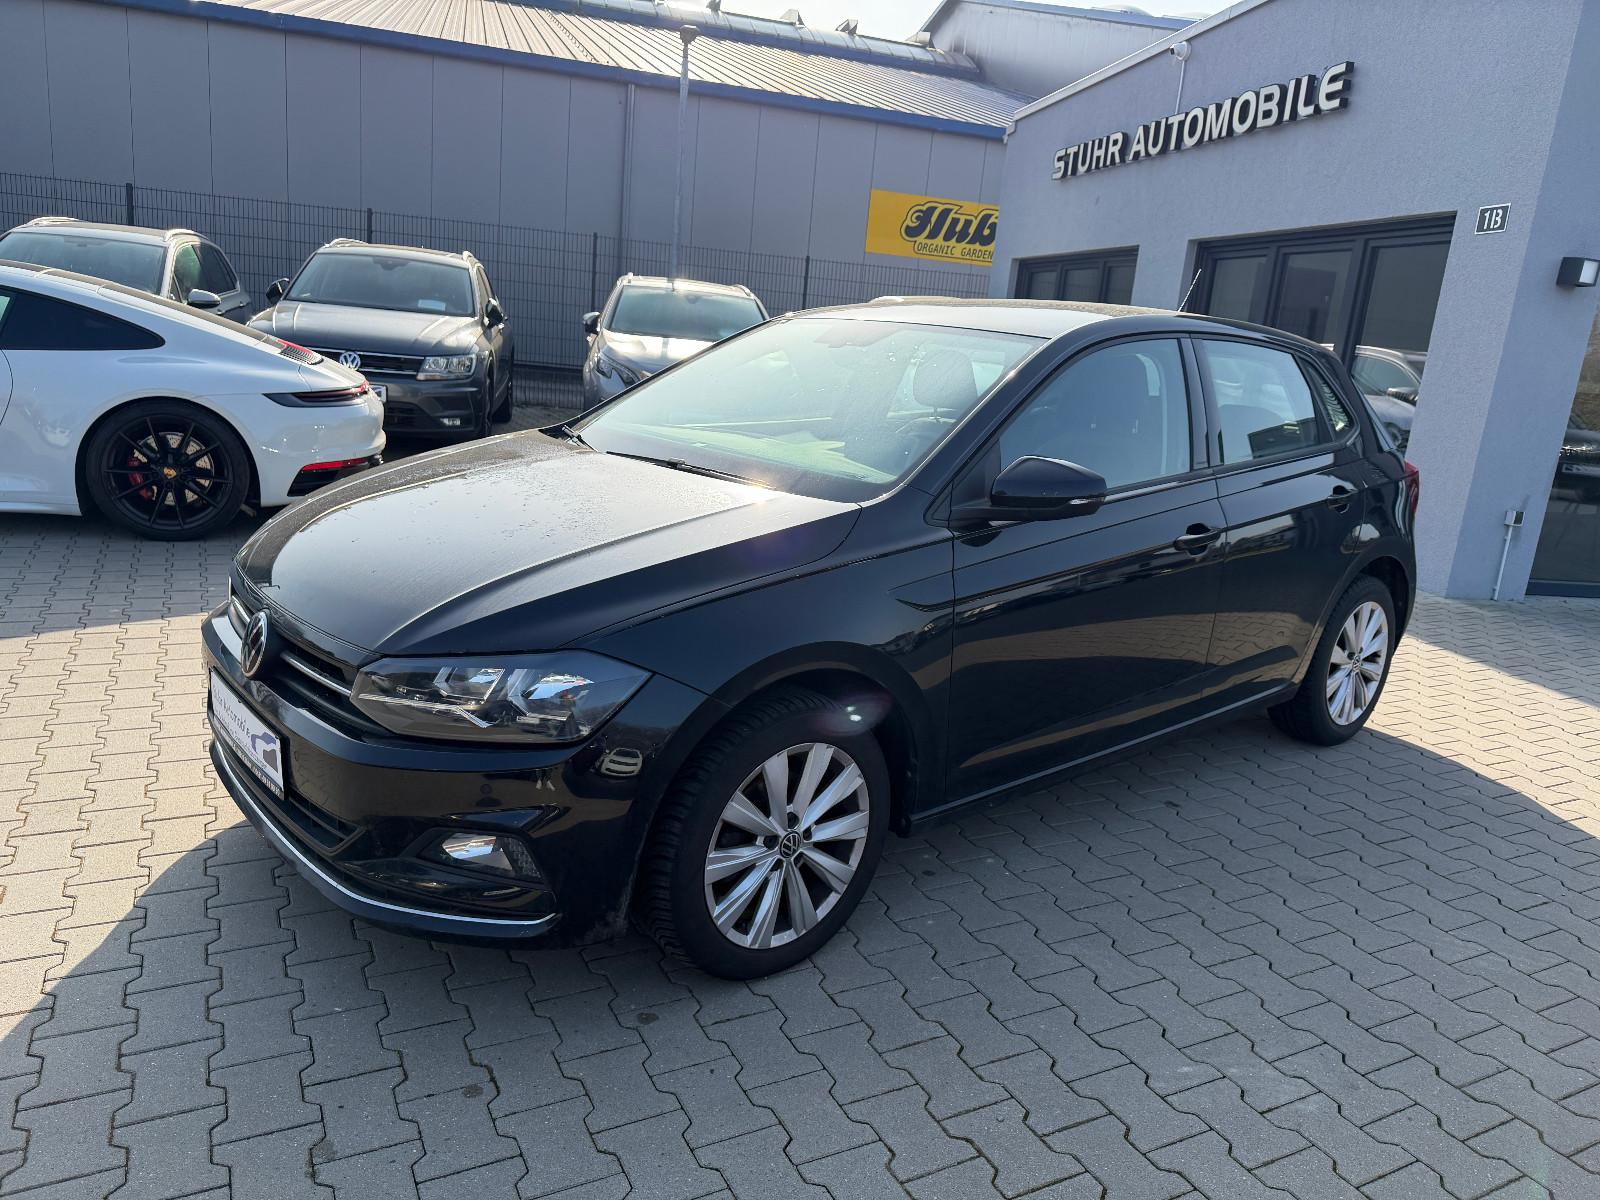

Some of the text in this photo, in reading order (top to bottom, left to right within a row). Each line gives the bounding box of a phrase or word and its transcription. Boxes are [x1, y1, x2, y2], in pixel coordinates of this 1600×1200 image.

[1052, 61, 1355, 180] STUHR AUTOMOBILE
[917, 242, 955, 256] ORGANIC
